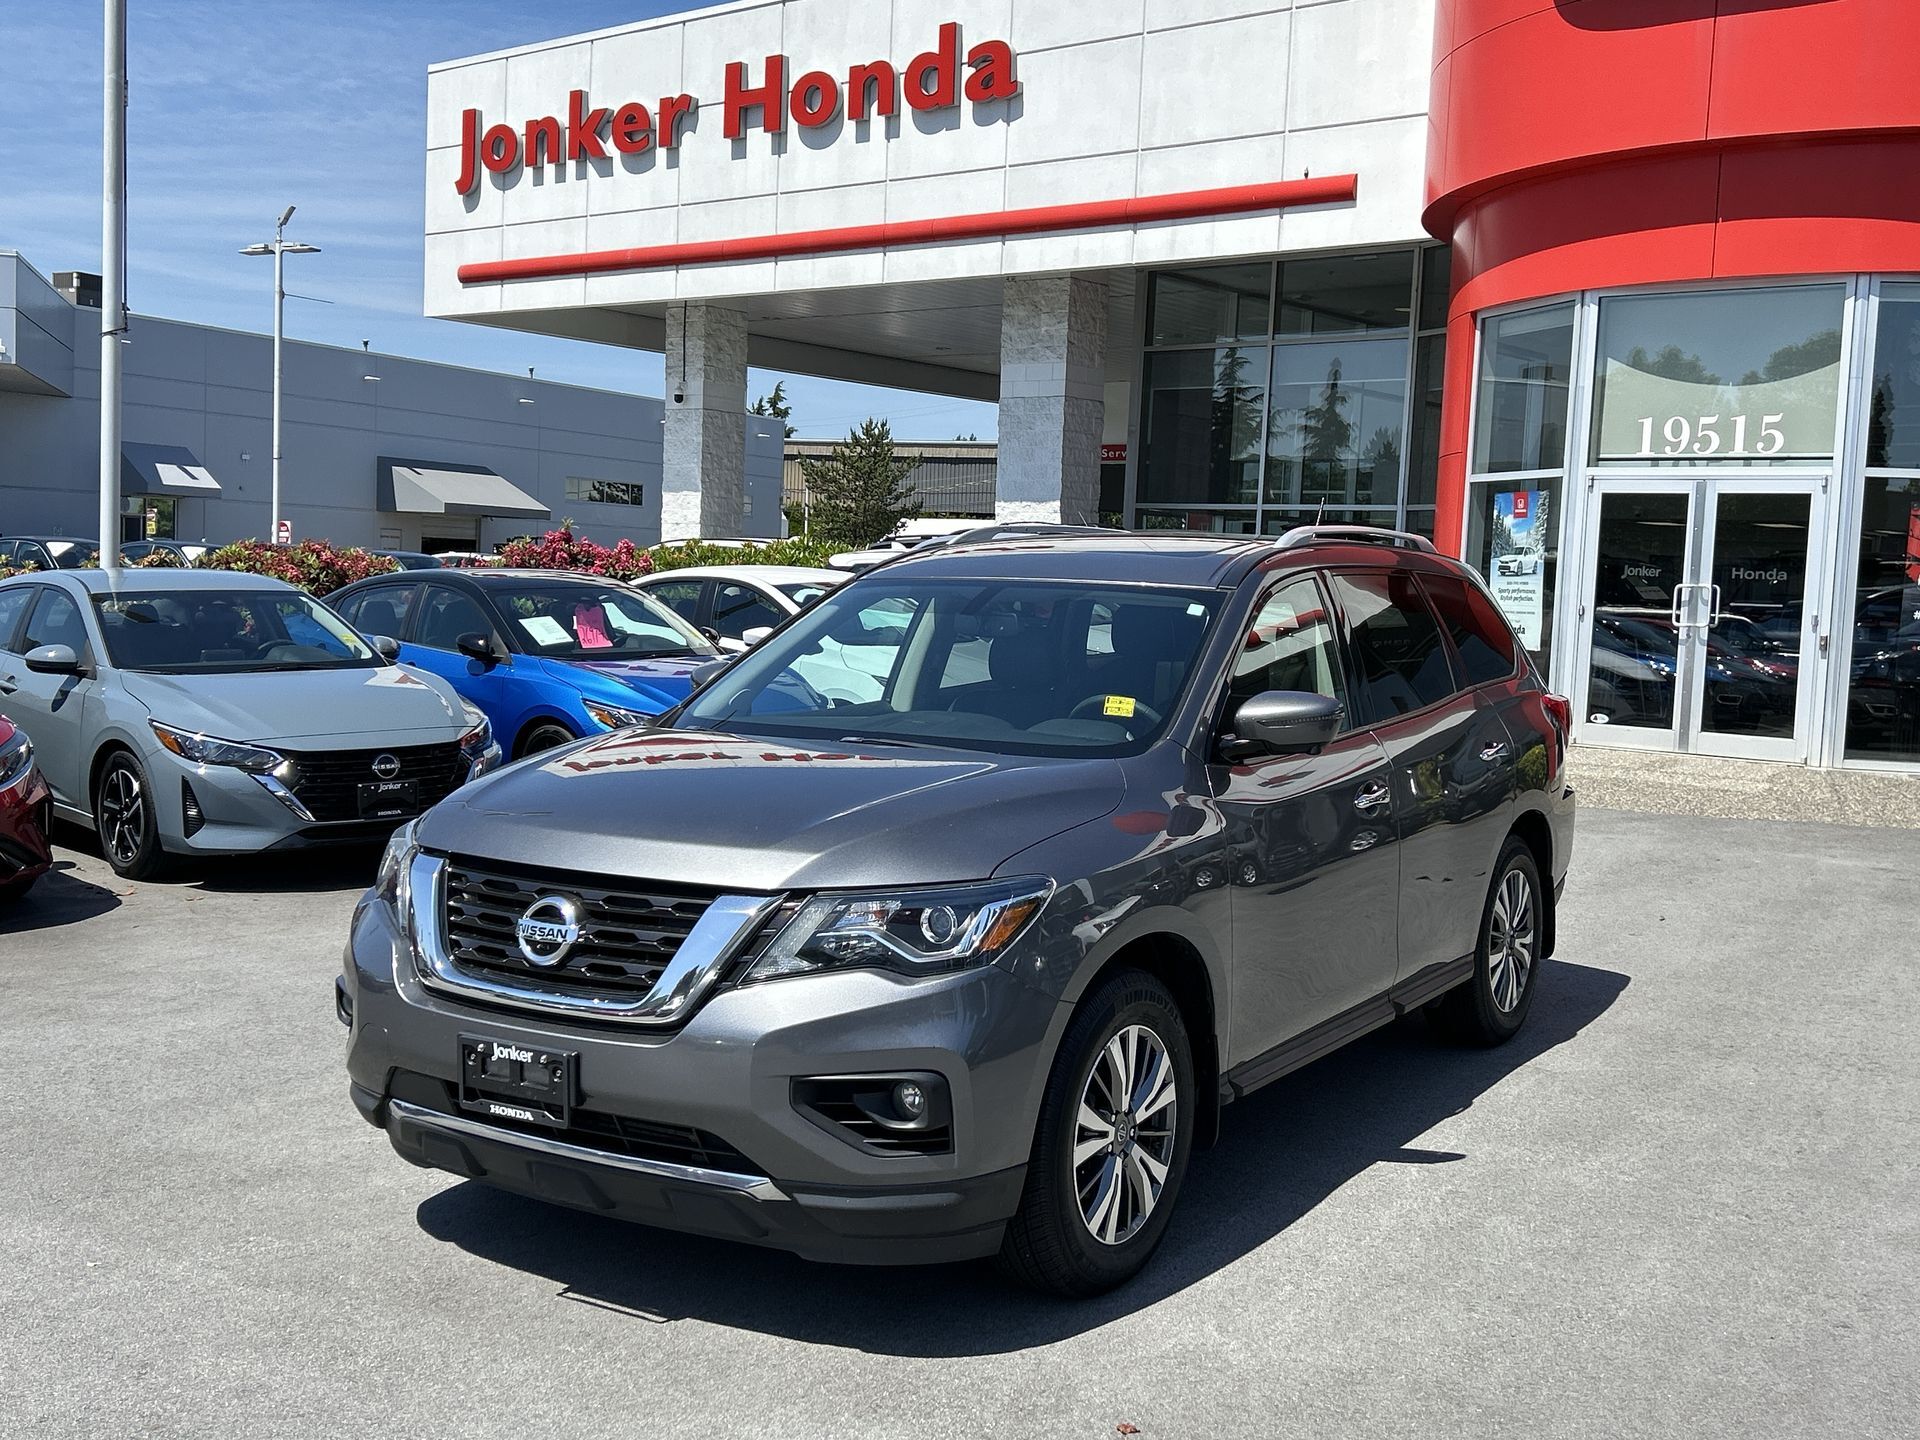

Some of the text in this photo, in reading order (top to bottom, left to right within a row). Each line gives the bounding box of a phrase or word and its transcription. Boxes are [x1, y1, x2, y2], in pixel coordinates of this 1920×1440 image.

[455, 22, 1021, 196] Jonker Honda
[1636, 413, 1784, 455] 19515
[1621, 565, 1788, 581] Jonker Honda
[519, 922, 569, 940] NISSAN
[492, 1043, 534, 1064] Jonker
[490, 1104, 534, 1121] HONDA
